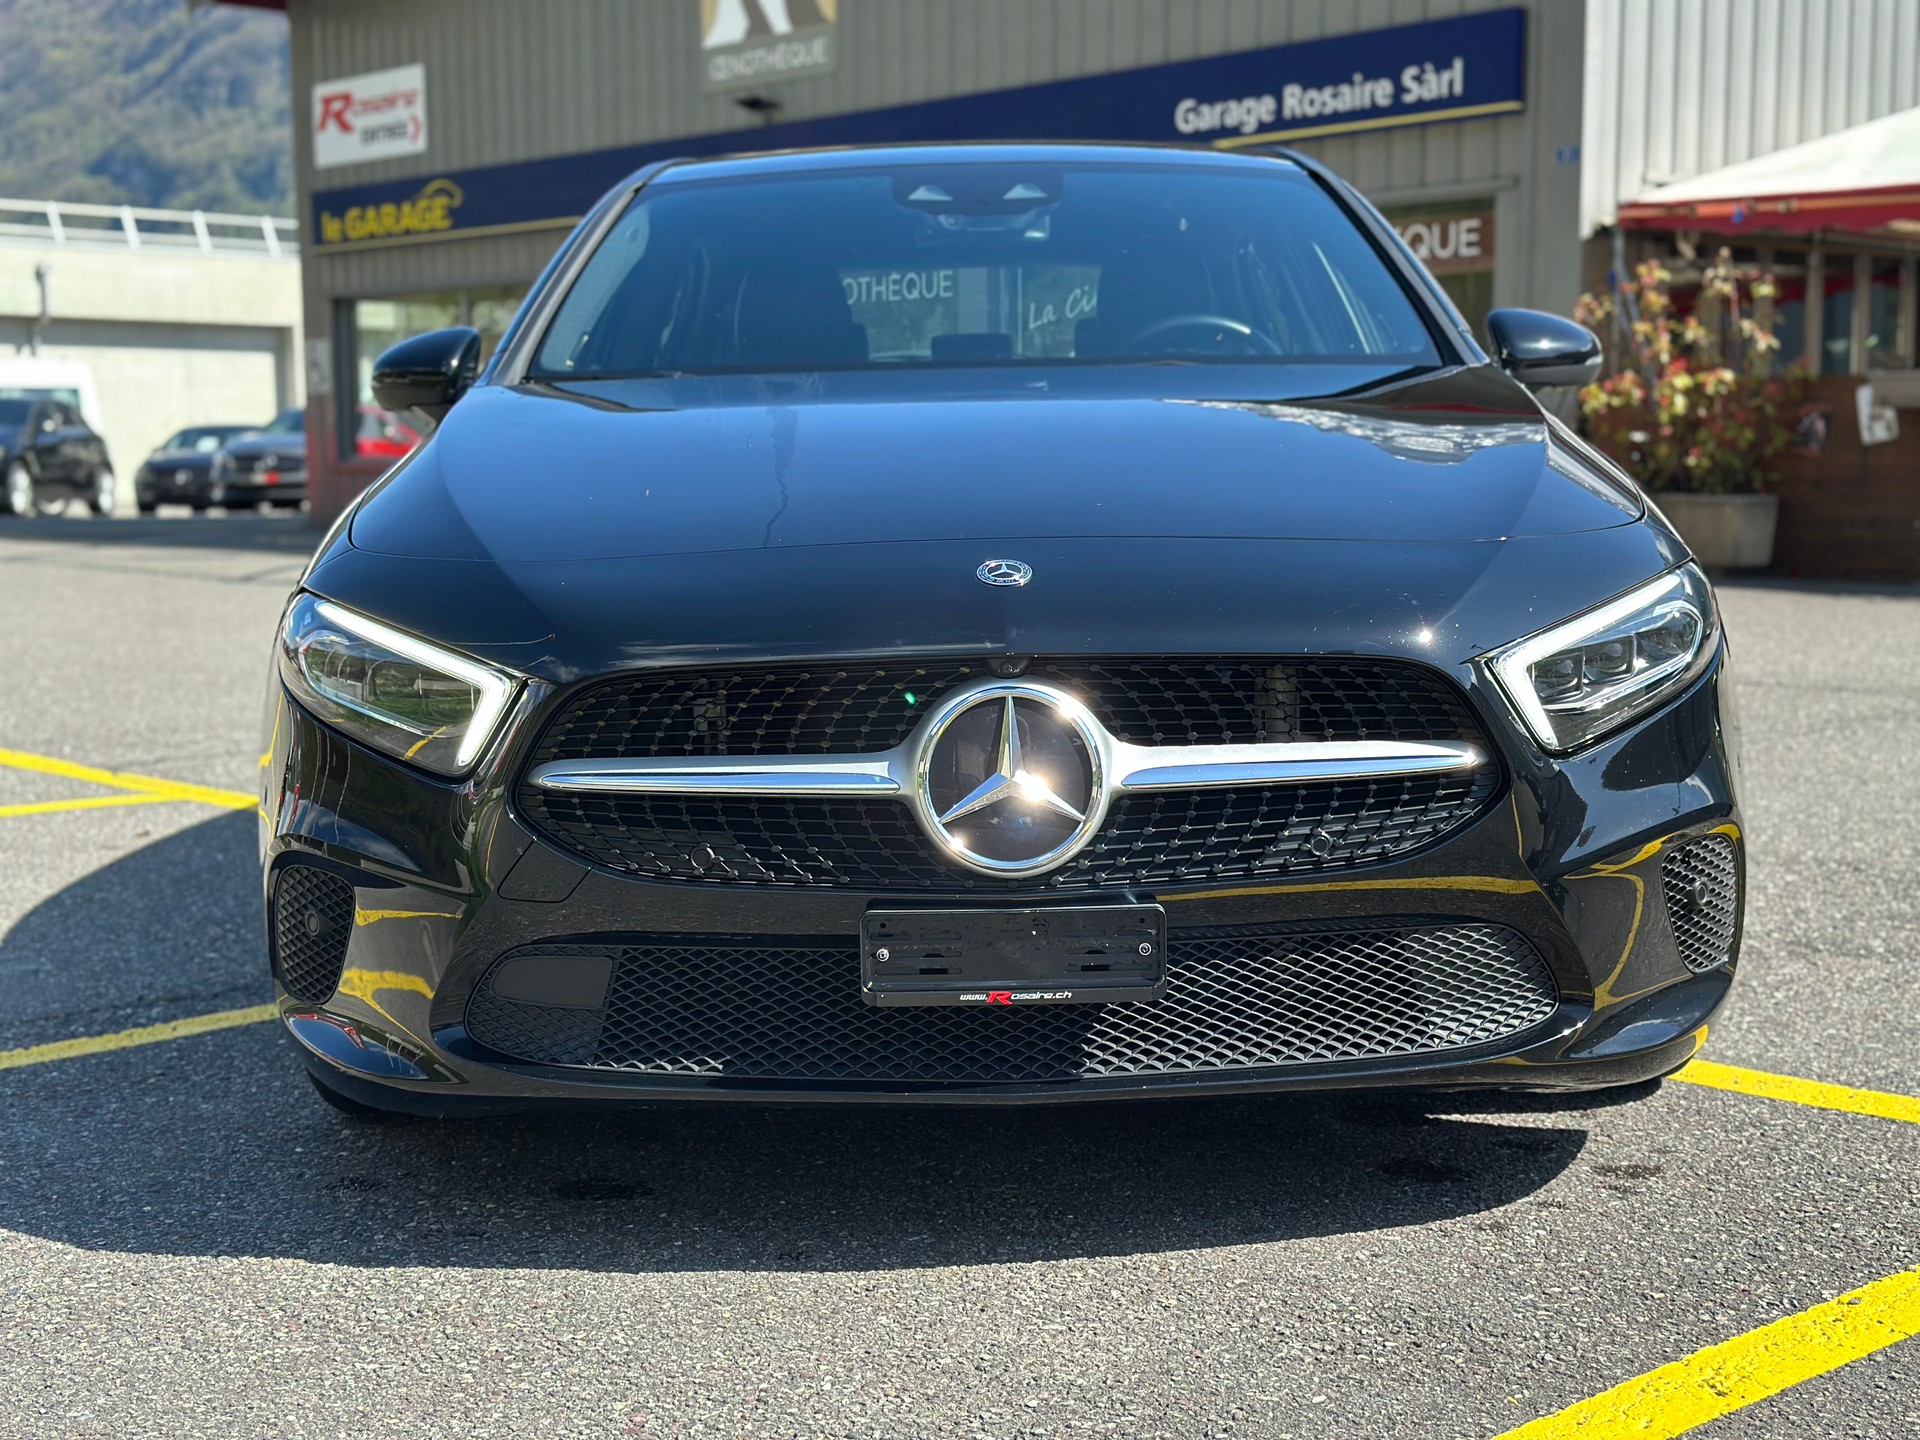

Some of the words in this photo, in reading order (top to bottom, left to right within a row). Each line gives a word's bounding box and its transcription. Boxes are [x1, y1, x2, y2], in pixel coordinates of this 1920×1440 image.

[1174, 95, 1278, 134] Garage
[1282, 72, 1394, 119] Rosaire
[1402, 57, 1464, 103] Sàrl
[321, 211, 342, 242] le
[344, 196, 452, 239] GARAGE
[1394, 218, 1482, 258] QUE
[1028, 302, 1056, 330] La
[960, 991, 1072, 1005] www.Rosaire.ch
